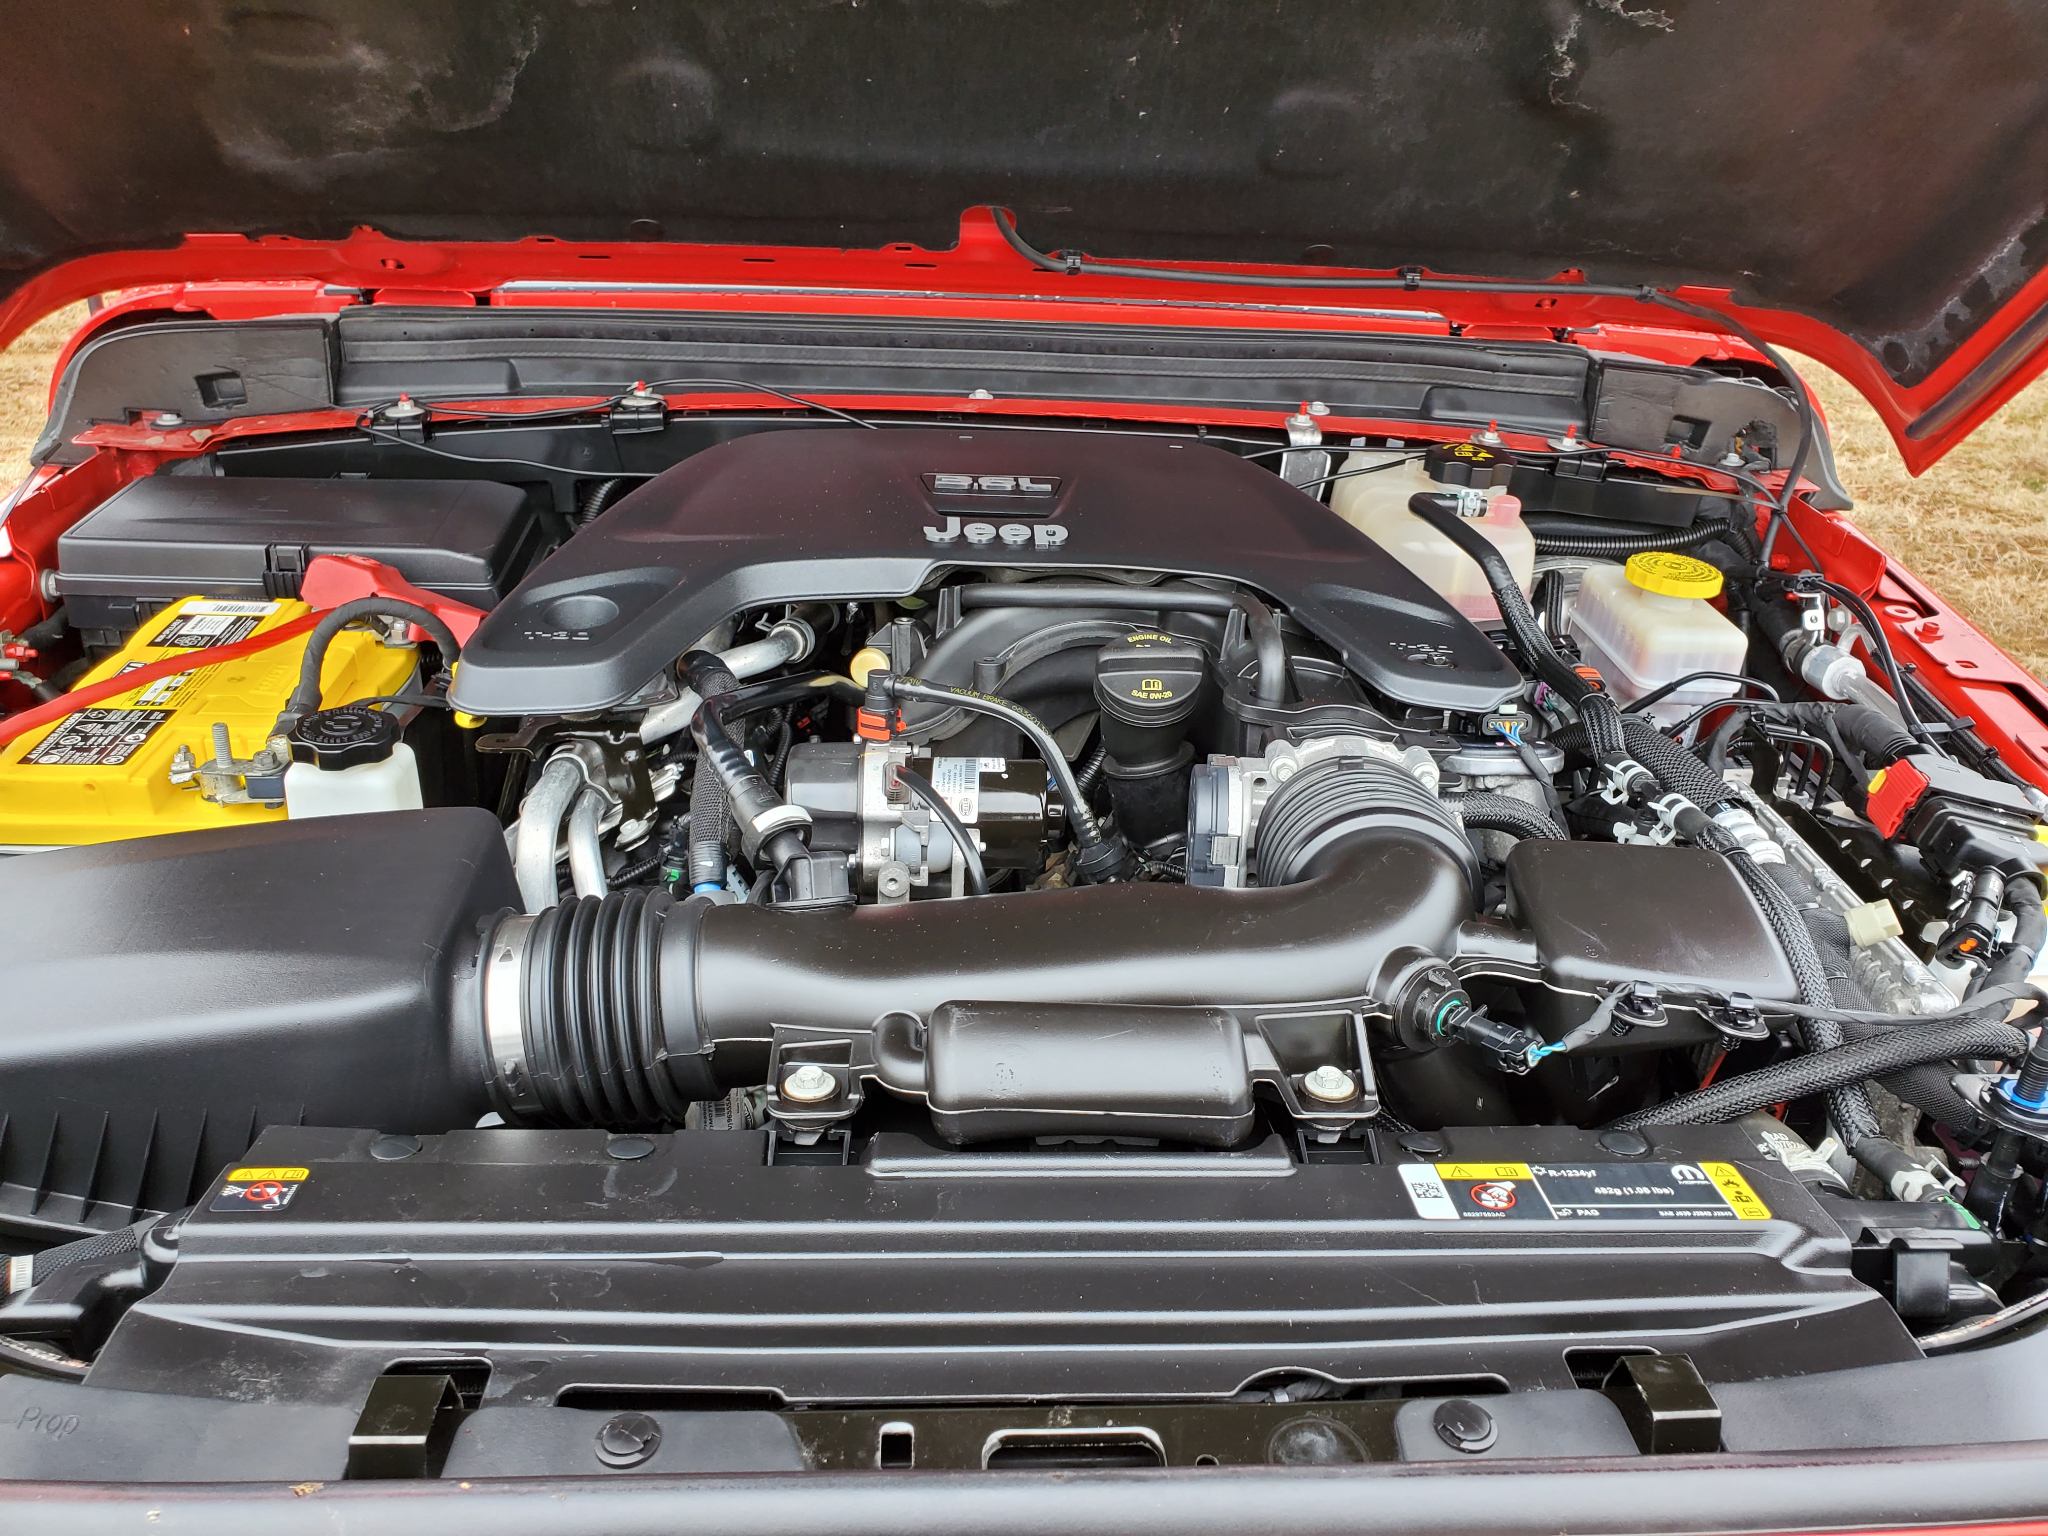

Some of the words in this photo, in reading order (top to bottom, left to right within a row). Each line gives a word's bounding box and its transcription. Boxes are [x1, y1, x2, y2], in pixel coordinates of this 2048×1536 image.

[923, 517, 1069, 550] Jeep
[1127, 634, 1158, 644] ENGINE
[1159, 634, 1172, 644] OIL
[950, 686, 980, 698] VACUUM
[982, 693, 1008, 707] BRAKE
[1131, 689, 1148, 699] SAE
[1149, 690, 1173, 700] 0W-20
[1549, 1169, 1596, 1179] R-1234yf
[1652, 1186, 1675, 1196] lbs)
[17, 1406, 80, 1440] Prop
